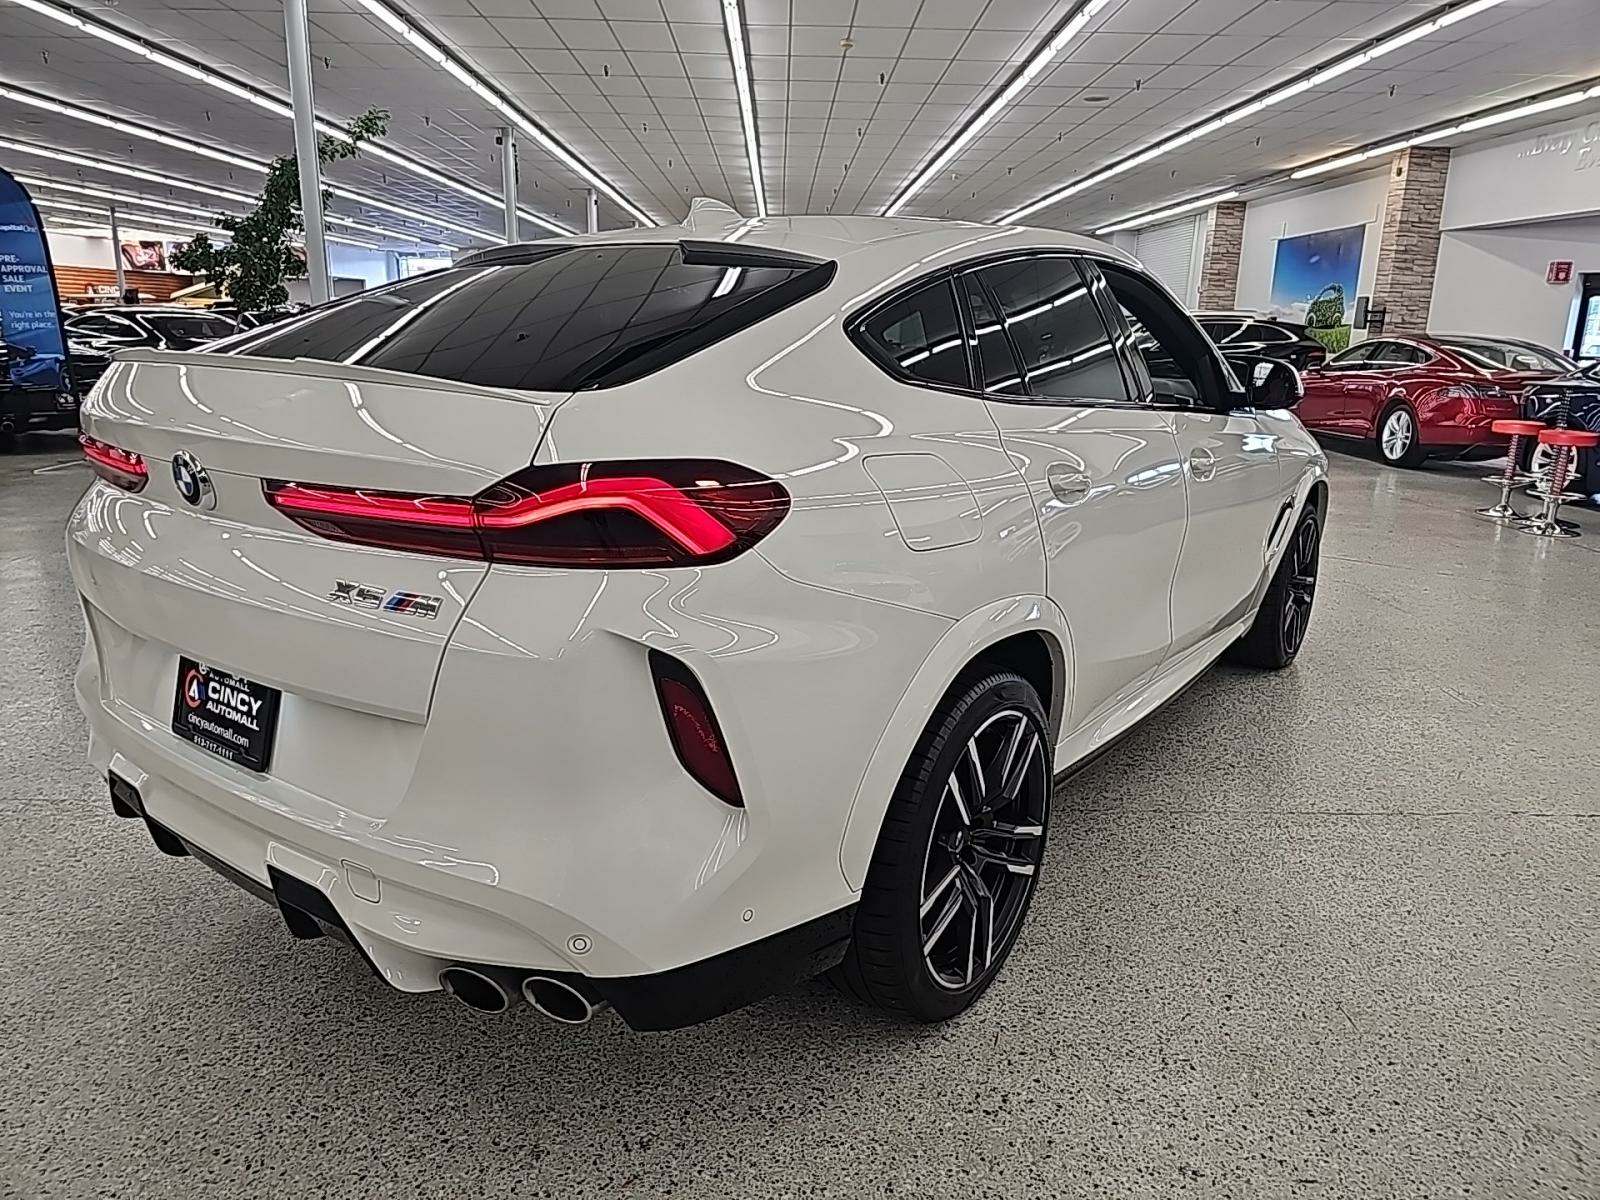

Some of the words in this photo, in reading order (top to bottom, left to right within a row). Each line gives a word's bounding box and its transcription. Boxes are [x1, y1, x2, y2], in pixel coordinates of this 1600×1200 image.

[0, 254, 20, 263] PRE-
[1, 265, 48, 273] APPROVAL
[2, 274, 25, 283] SALE
[4, 284, 33, 293] EVENT
[98, 285, 120, 294] CINC
[9, 310, 33, 319] You're
[34, 310, 43, 318] in
[11, 321, 30, 331] right
[208, 681, 263, 716] CINCY
[206, 701, 260, 731] AUTOMALL
[188, 712, 250, 748] cincyautomall.com
